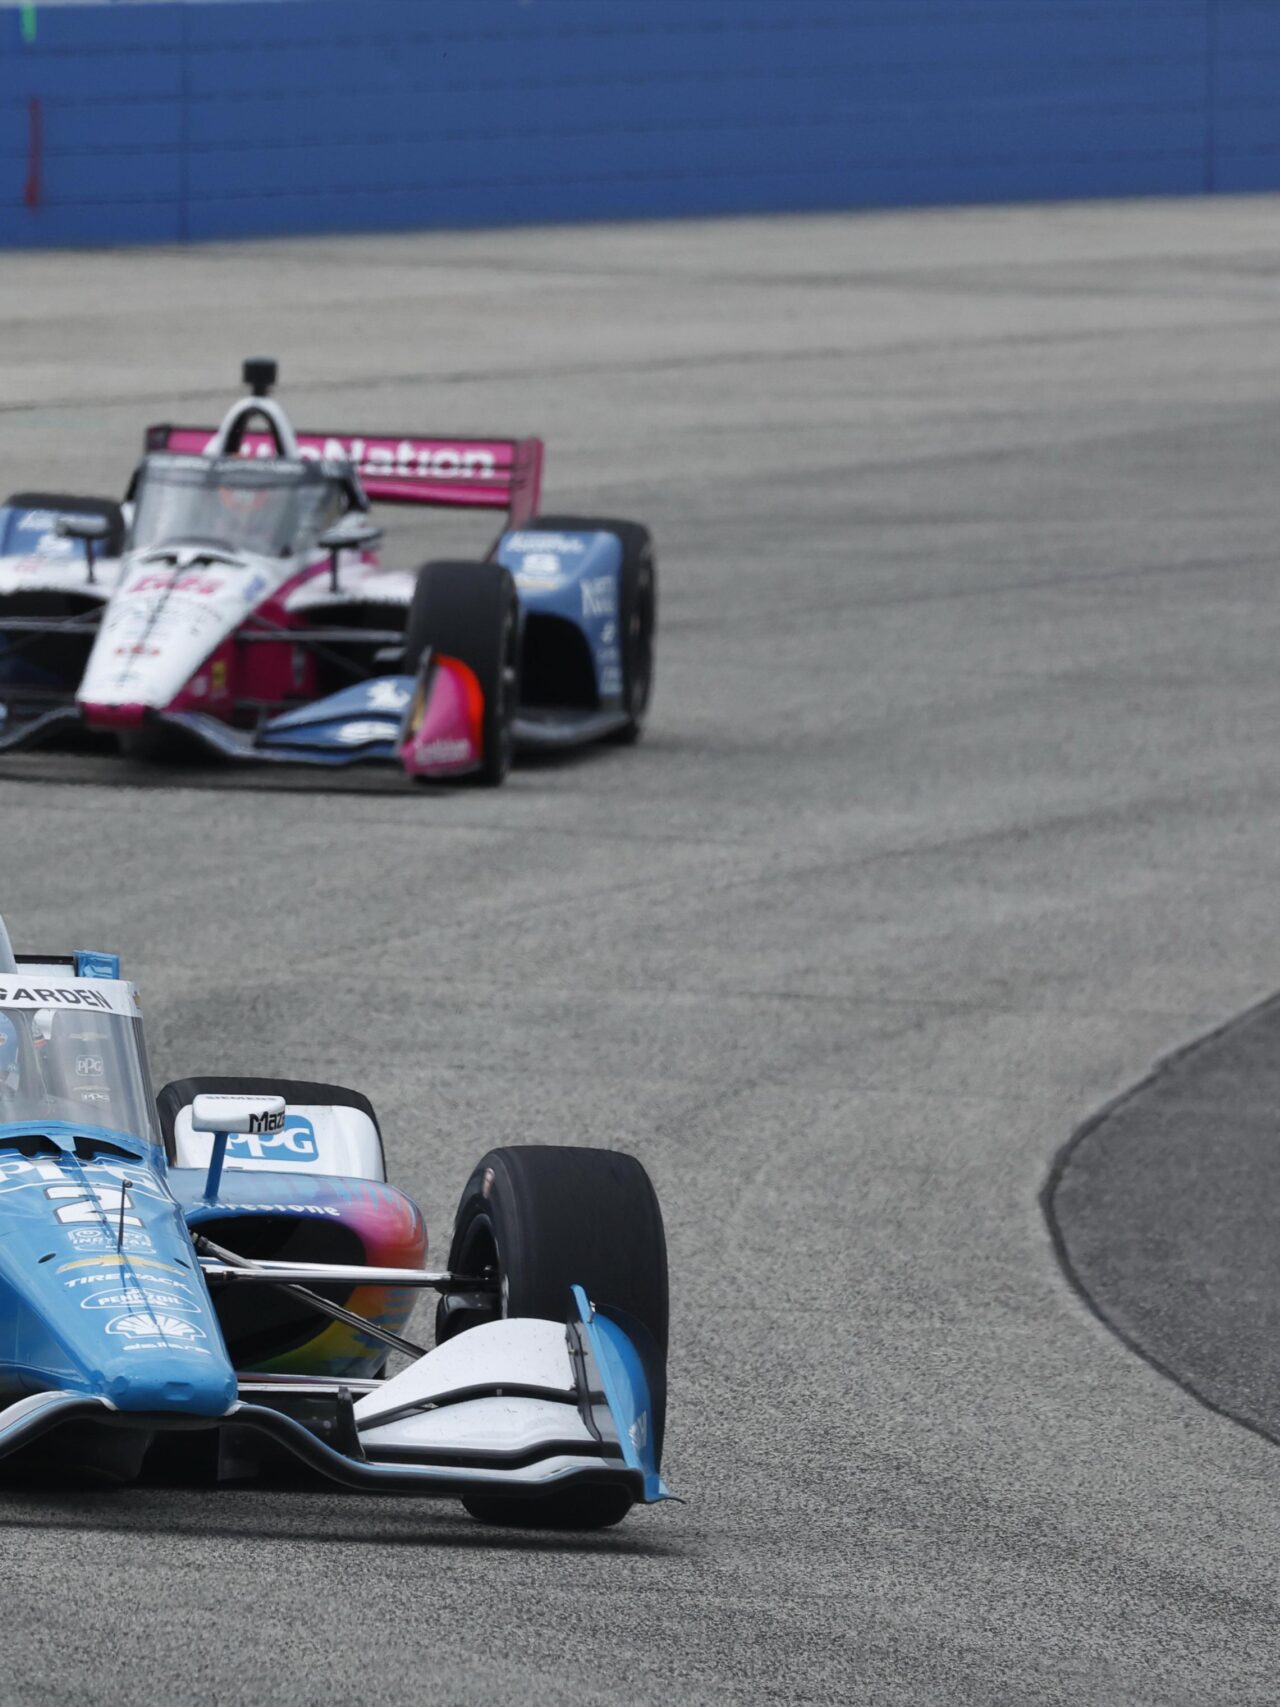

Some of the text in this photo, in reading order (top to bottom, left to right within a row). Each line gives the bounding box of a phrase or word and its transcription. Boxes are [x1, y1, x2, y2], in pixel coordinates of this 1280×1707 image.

[79, 1058, 101, 1074] PPG
[249, 1110, 286, 1133] Maz
[46, 1186, 143, 1228] 2
